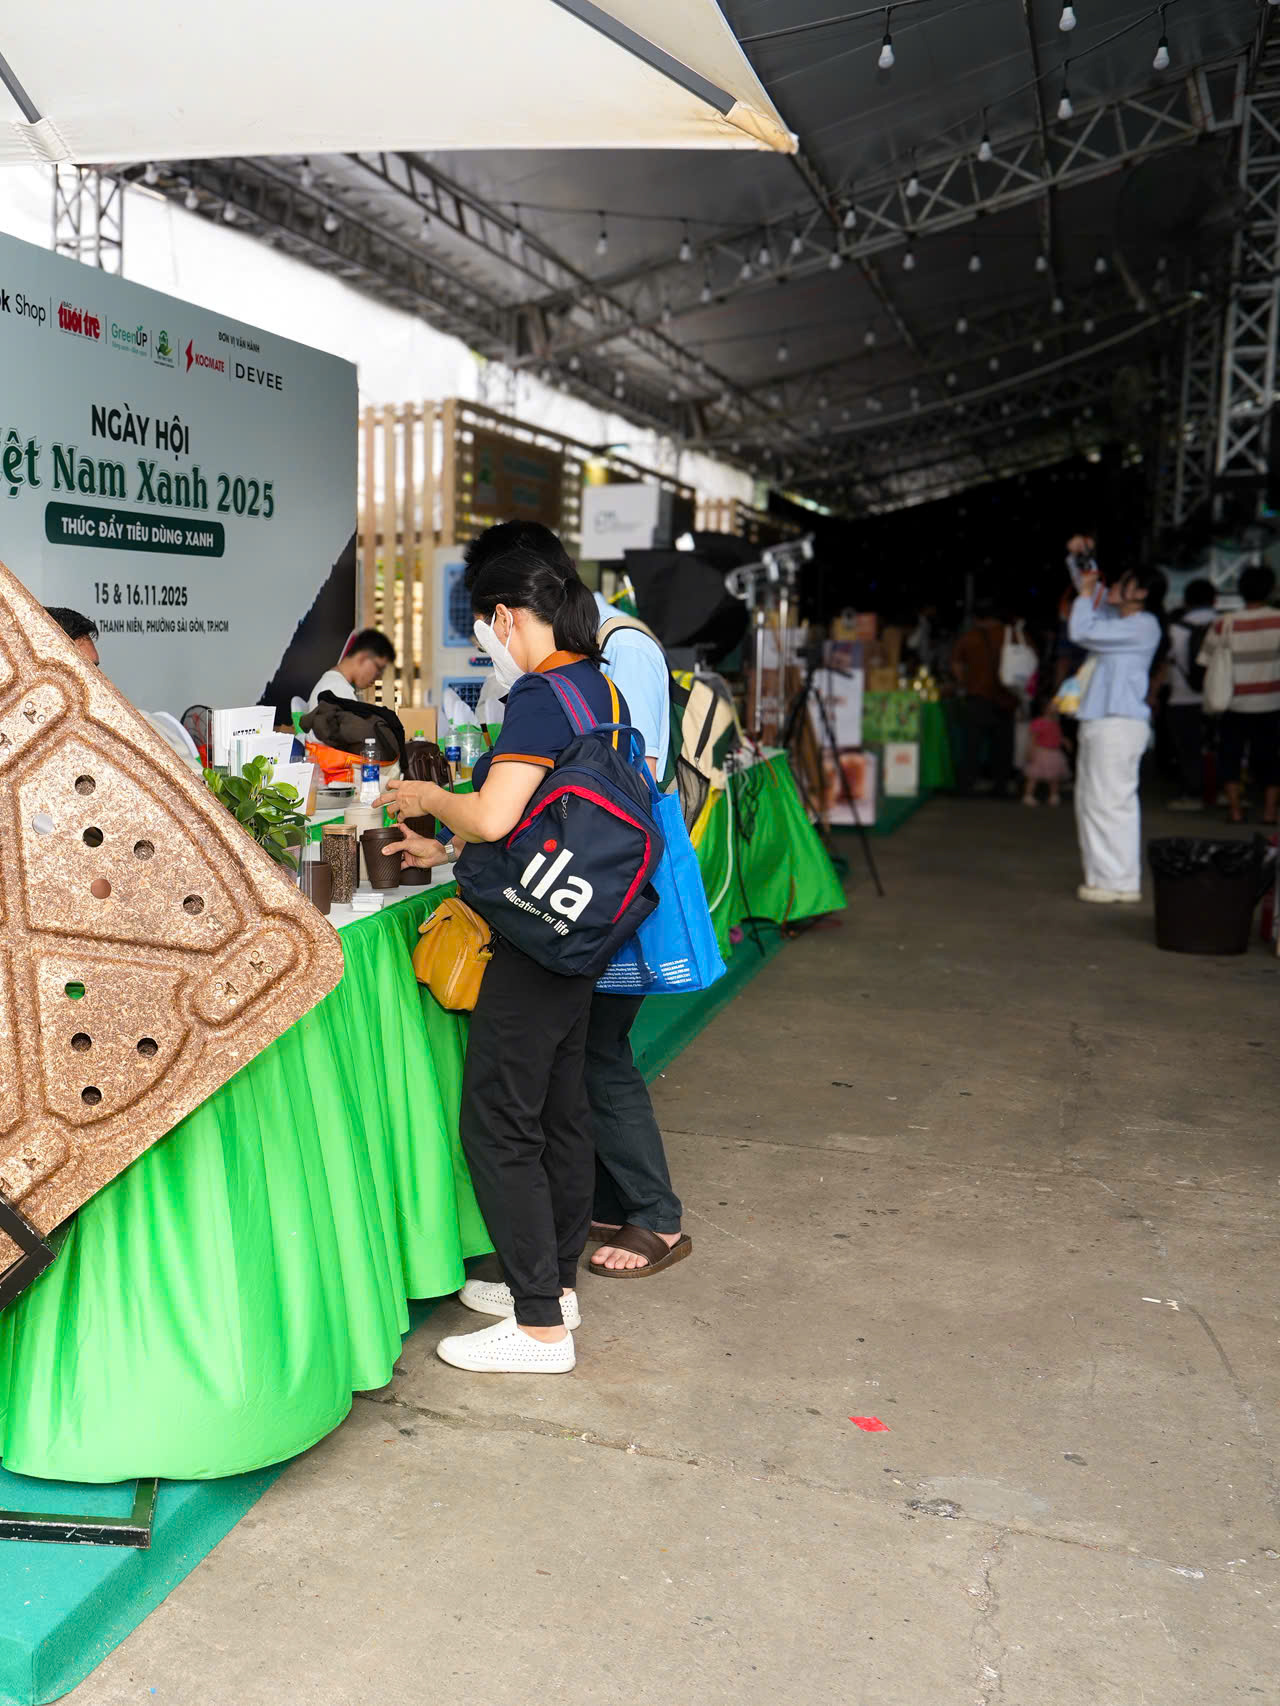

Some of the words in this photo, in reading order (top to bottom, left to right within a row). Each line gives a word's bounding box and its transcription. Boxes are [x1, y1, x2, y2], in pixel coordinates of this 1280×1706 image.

[15, 293, 47, 327] Shop
[194, 353, 225, 374] KOCMATE
[235, 363, 284, 391] DEVEE
[90, 402, 150, 446] NGÀY
[156, 417, 190, 461] HỘI
[52, 444, 128, 501] Nam
[137, 461, 209, 511] Xanh
[216, 474, 276, 520] 2025
[60, 514, 96, 538] THÚC
[98, 514, 124, 541] ĐẨY
[126, 521, 150, 545] TIÊU
[151, 523, 183, 547] DÙNG
[184, 529, 215, 549] XANH
[94, 583, 109, 604] 15
[113, 583, 123, 605] &
[125, 583, 189, 607] 16.11.2025
[99, 619, 125, 633] THANH
[126, 617, 145, 635] NIÊN,
[146, 617, 176, 633] PHƯỜNG
[177, 617, 188, 633] SÀI
[207, 620, 229, 633] TP.HCM
[520, 839, 594, 922] ila
[502, 886, 542, 916] education
[542, 911, 554, 924] for
[553, 920, 569, 936] life
